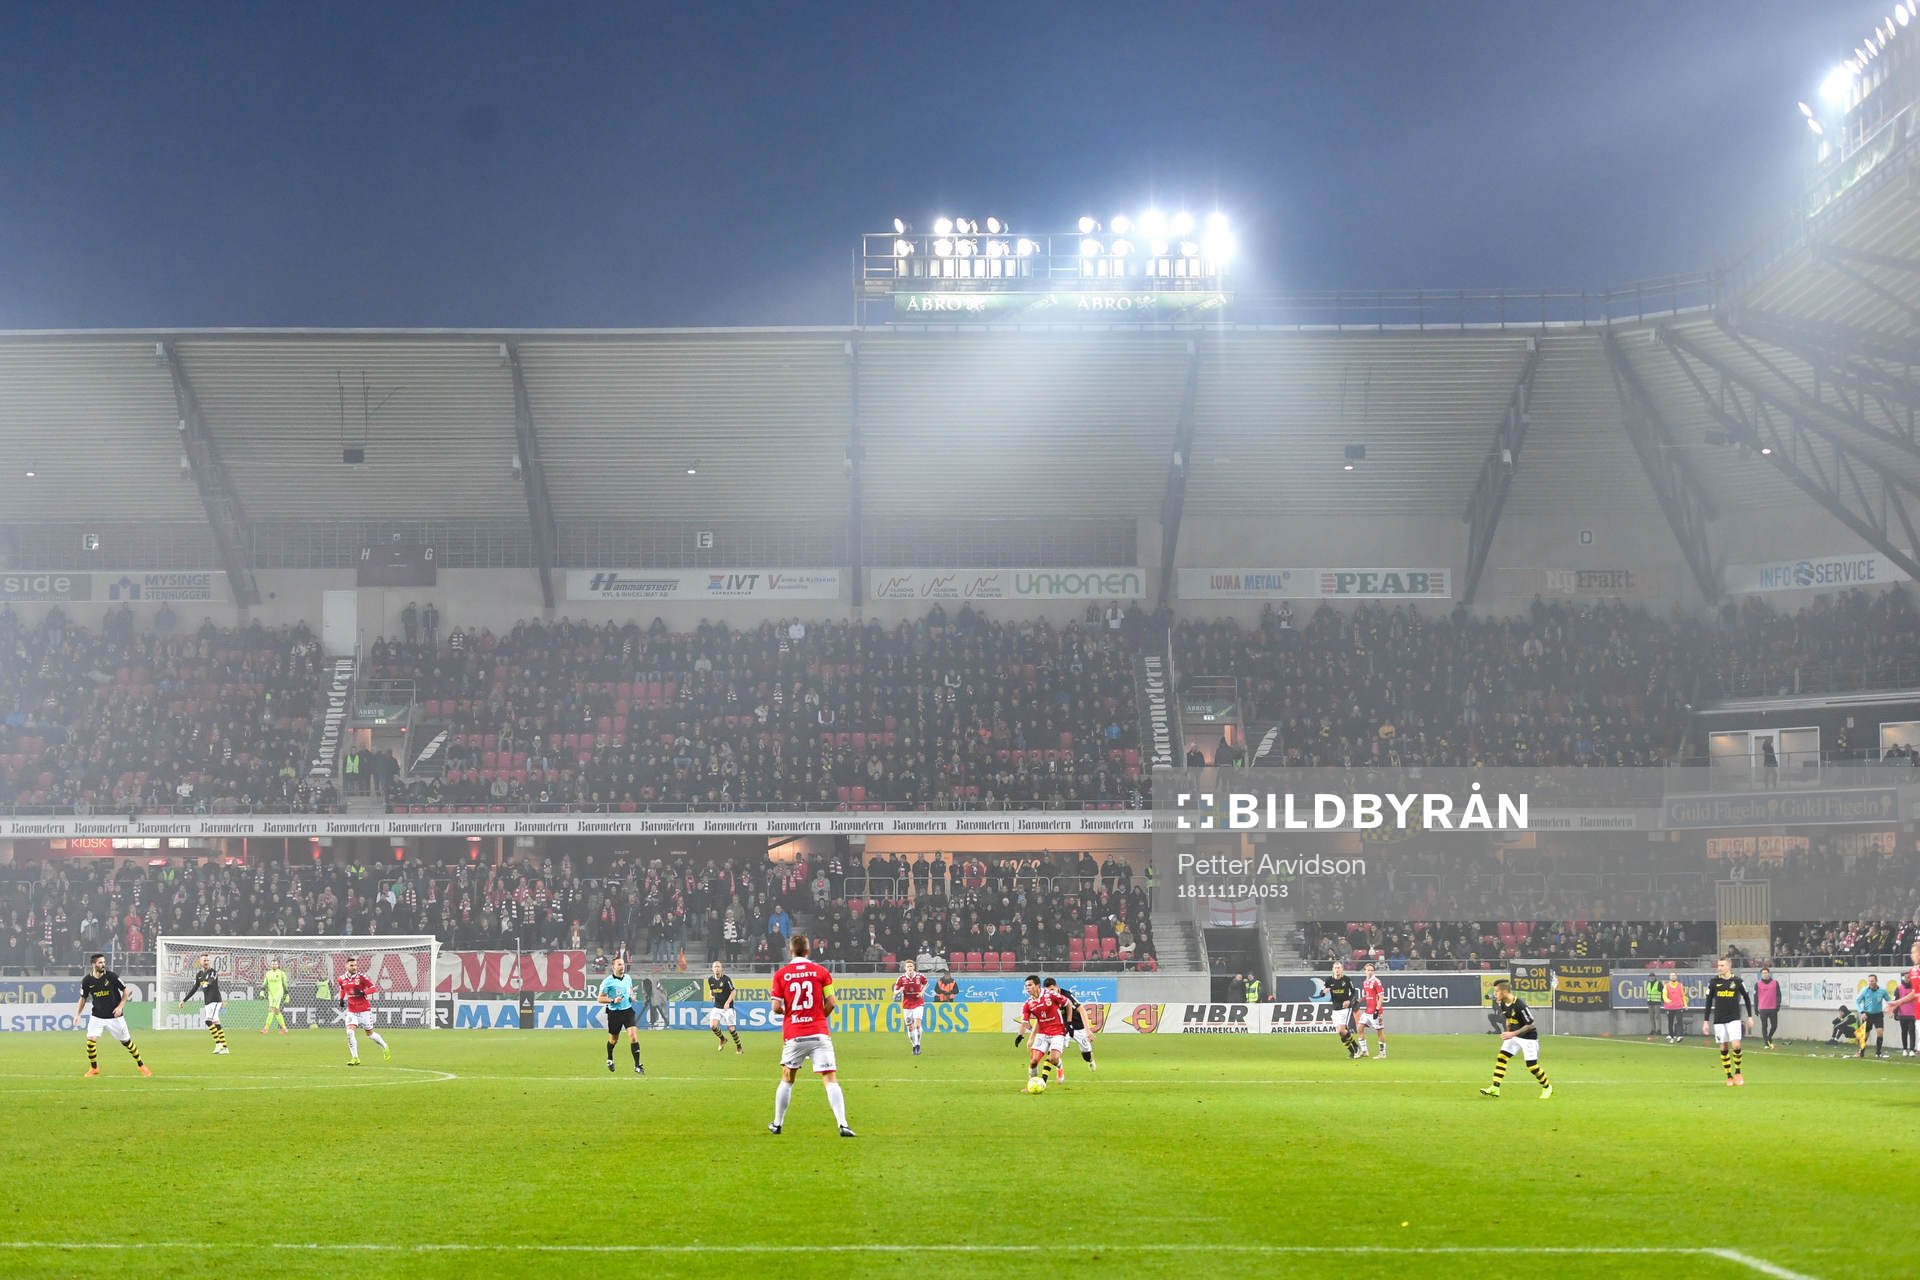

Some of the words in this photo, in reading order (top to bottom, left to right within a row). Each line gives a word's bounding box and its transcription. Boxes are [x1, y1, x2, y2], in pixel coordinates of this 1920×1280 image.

[360, 548, 370, 560] H
[425, 548, 434, 560] G
[145, 575, 210, 586] MYSINGE
[726, 574, 761, 591] IVT
[1760, 566, 1791, 588] INFO
[1815, 560, 1875, 584] SERVICE
[4, 576, 71, 593] side
[1015, 573, 1140, 594] UNIONEN
[1210, 576, 1241, 591] LUMA
[1244, 575, 1282, 591] METALL
[1335, 572, 1431, 594] PEAB
[1671, 802, 1711, 823] Guld
[1714, 798, 1767, 823] Fågeln
[1780, 797, 1821, 819] Guld
[1825, 795, 1879, 820] Fågeln
[71, 839, 107, 849] KIOSK
[1530, 968, 1546, 977] ON
[1515, 978, 1547, 990] TOUR
[790, 981, 814, 1010] 23
[1716, 990, 1735, 998] notar
[830, 1003, 881, 1033] CITY
[886, 1003, 970, 1033] GOSS
[1183, 1005, 1249, 1022] HBR
[1271, 1005, 1334, 1022] HBR
